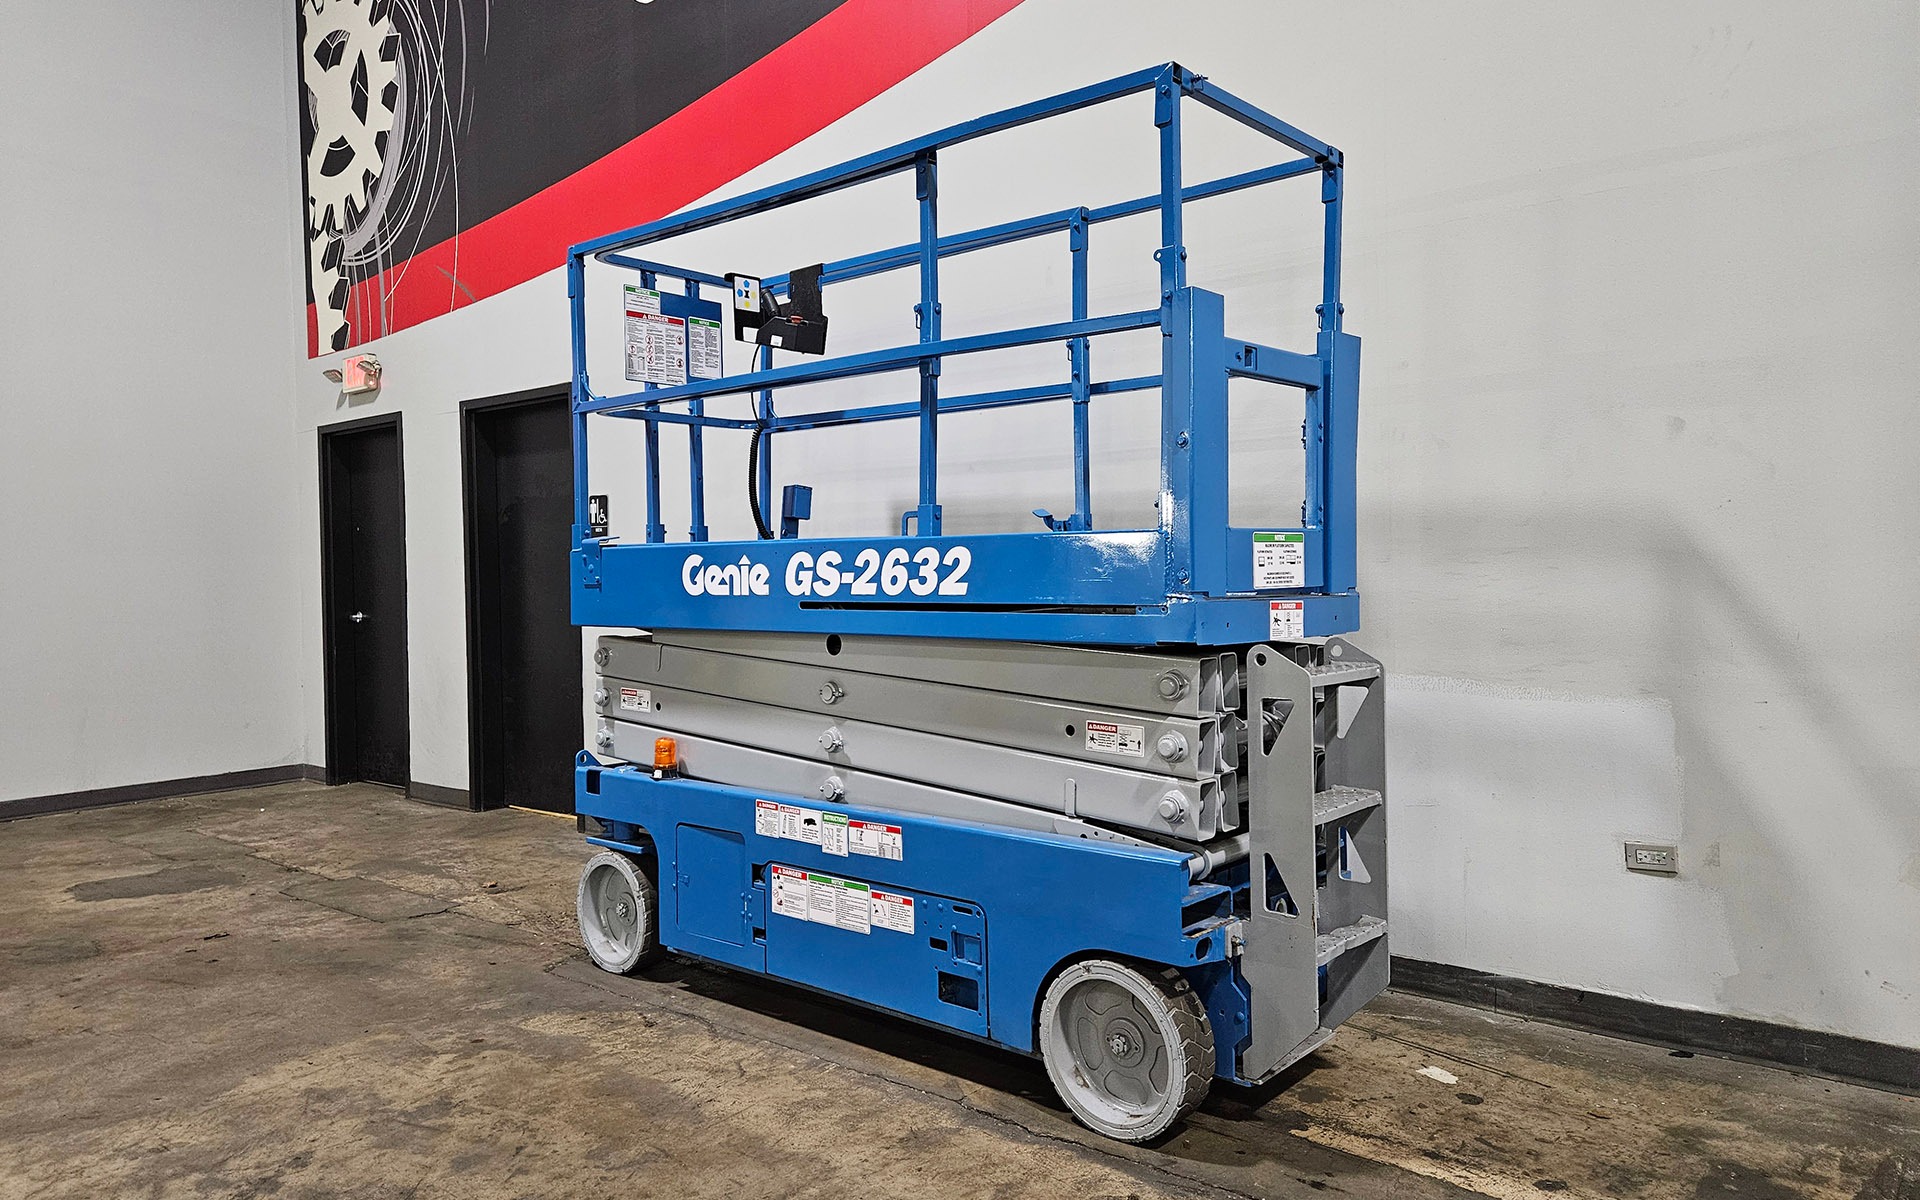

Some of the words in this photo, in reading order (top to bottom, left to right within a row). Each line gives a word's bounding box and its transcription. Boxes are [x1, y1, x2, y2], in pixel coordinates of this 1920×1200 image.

[648, 314, 669, 323] DANGER
[681, 553, 770, 597] Genie
[784, 545, 972, 597] GS-2632
[1092, 724, 1116, 732] DANGER
[762, 802, 777, 810] DANGER
[784, 806, 800, 814] DANGER
[867, 823, 887, 832] DANGER
[782, 868, 803, 879] DANGER
[884, 894, 904, 904] DANGER
